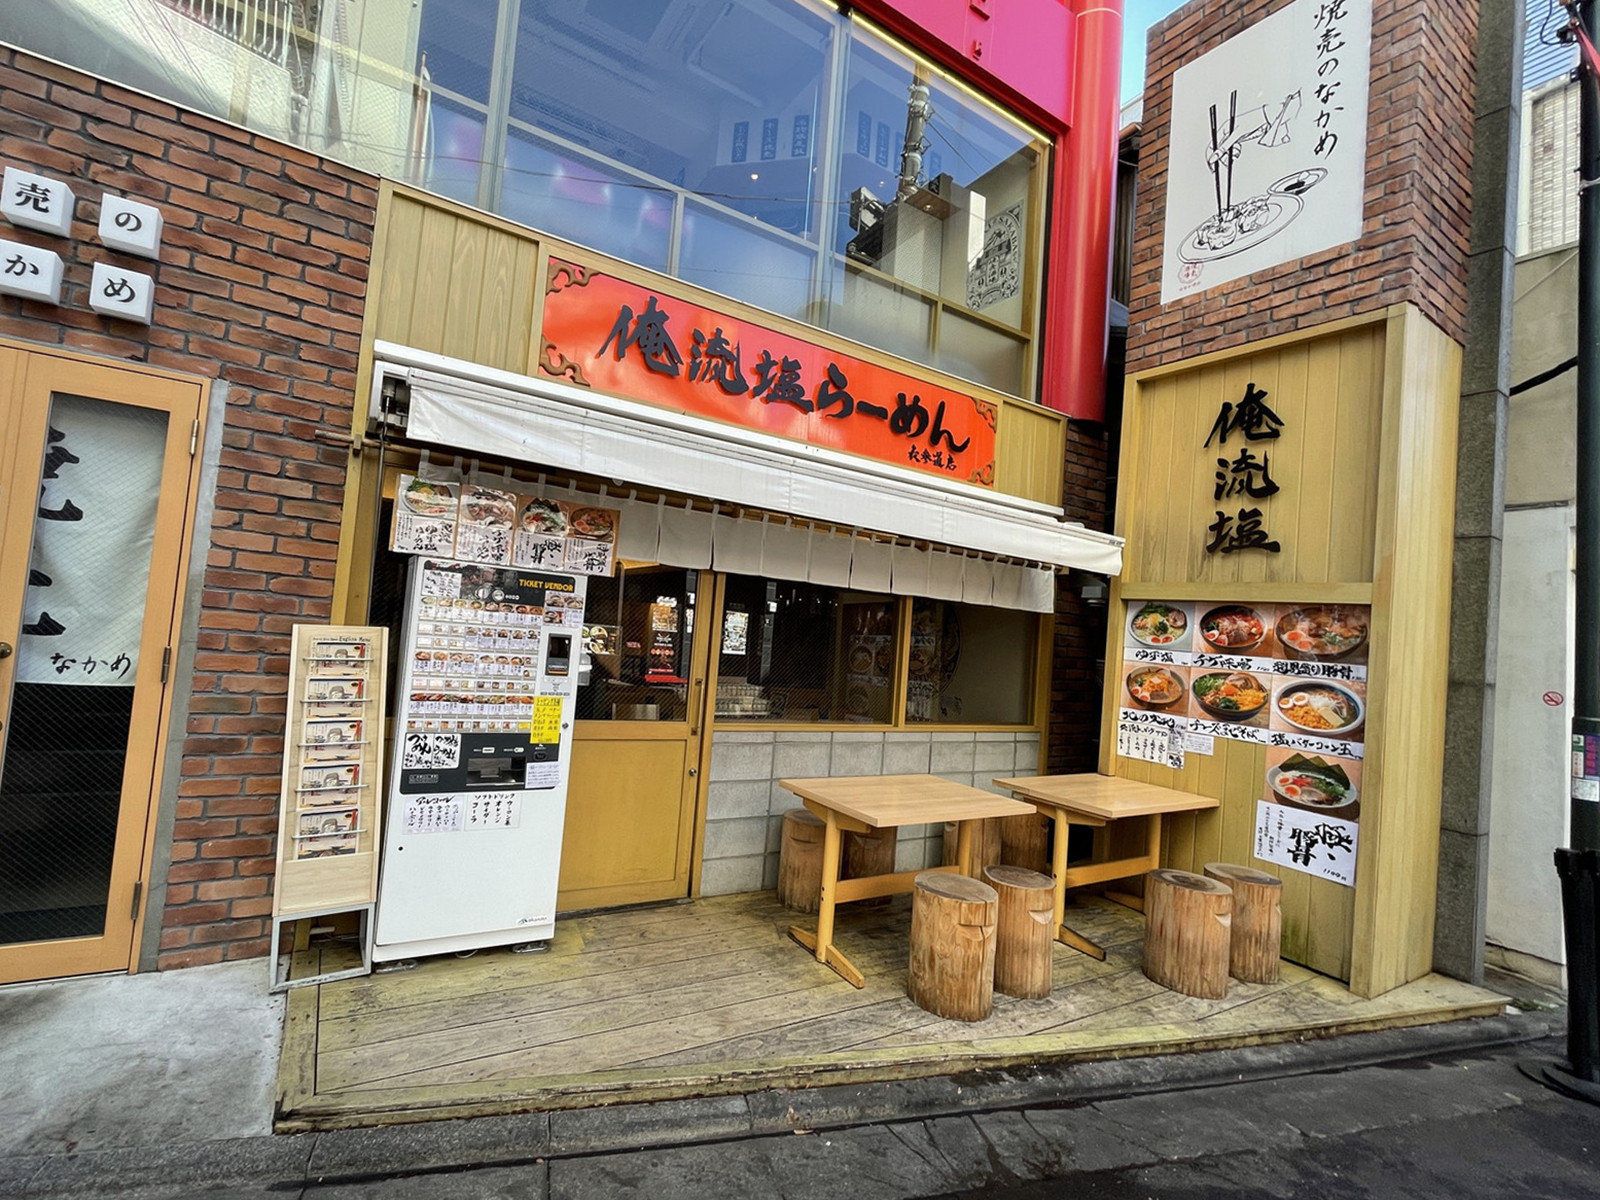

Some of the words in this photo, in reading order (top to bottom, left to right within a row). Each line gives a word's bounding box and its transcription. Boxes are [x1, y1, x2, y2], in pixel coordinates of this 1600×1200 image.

[1314, 0, 1348, 160] 焼売のなかめ
[599, 295, 971, 454] 俺流塩らーめん
[1203, 382, 1286, 554] 俺流塩
[519, 579, 543, 589] TICKET
[544, 581, 574, 592] VENDOR
[51, 652, 131, 679] なかめ
[1135, 649, 1175, 664] ゆず塩
[1193, 653, 1253, 671] チゲ味噌
[1189, 719, 1259, 741] チーズまぜそば
[416, 795, 455, 805] アルコール
[471, 802, 479, 823] コーラ
